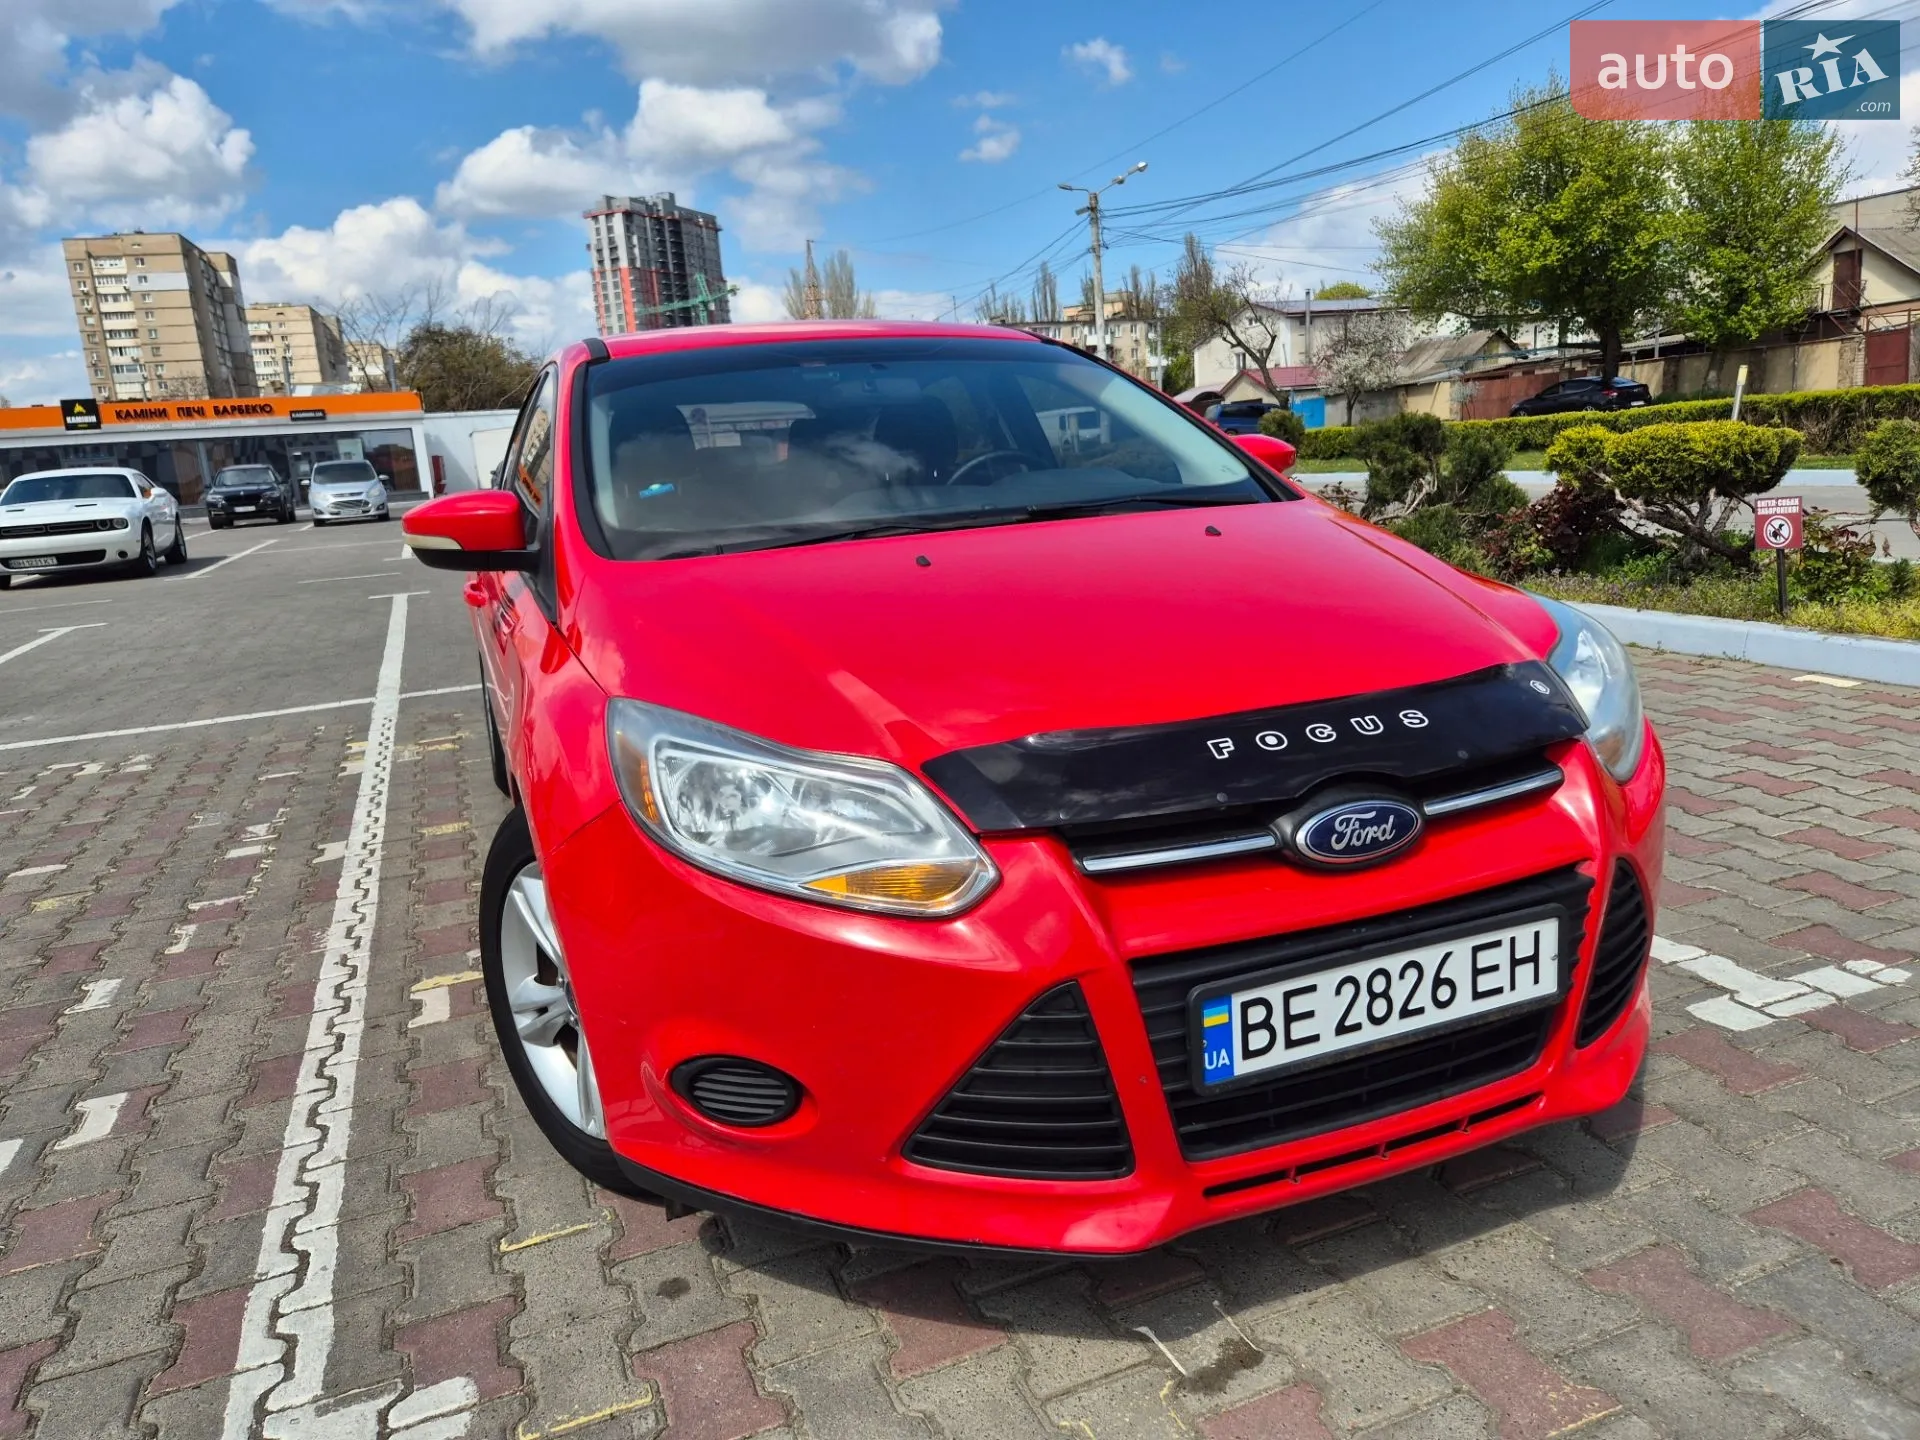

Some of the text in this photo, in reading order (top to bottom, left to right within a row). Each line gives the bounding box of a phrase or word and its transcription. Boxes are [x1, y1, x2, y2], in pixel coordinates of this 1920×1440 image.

[114, 403, 273, 420] КАМІНИ ПЕЧІ БАРБЕКЮ
[1206, 709, 1429, 760] FOCUS
[1330, 810, 1396, 851] Ford
[1240, 930, 1540, 1061] BE 2826 EH
[1204, 1048, 1231, 1070] UA
